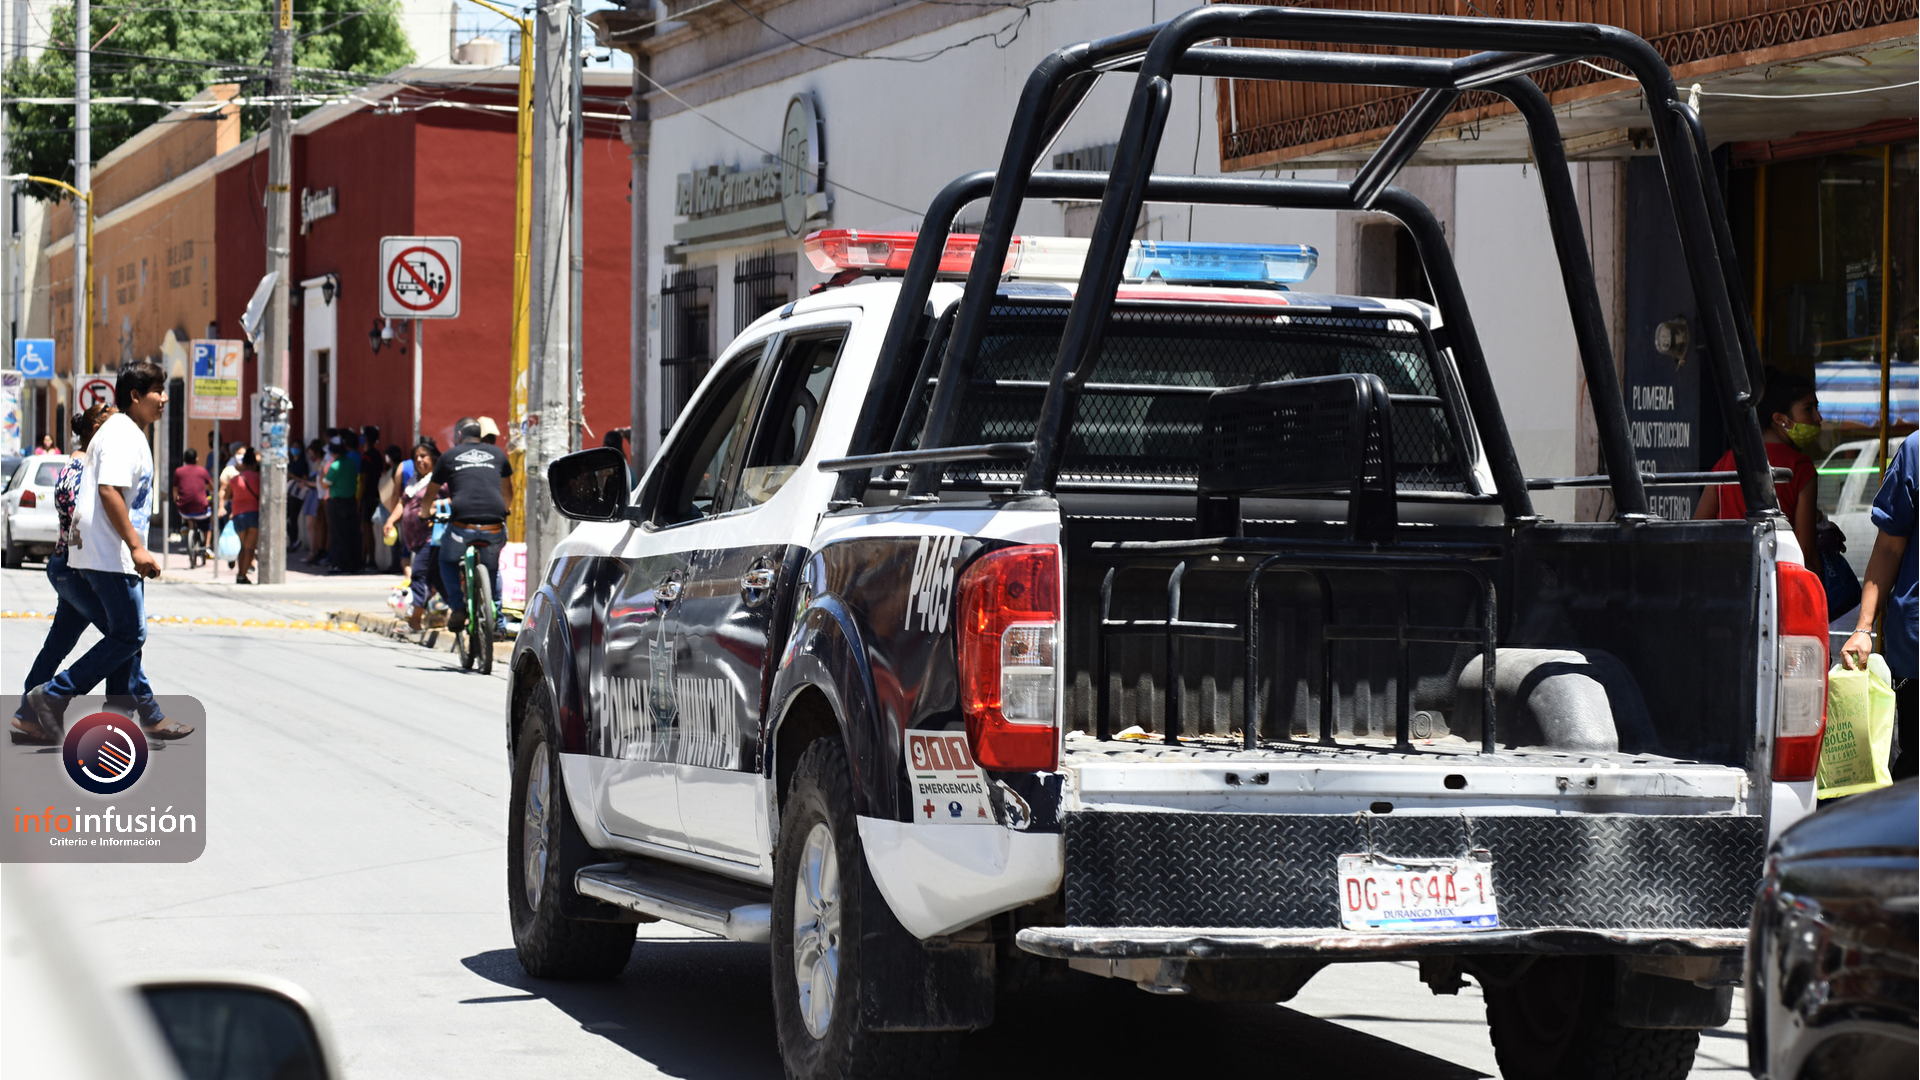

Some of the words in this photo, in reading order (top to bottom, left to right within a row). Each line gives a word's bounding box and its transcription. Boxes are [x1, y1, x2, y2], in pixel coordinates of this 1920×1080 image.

[195, 346, 208, 362] P
[1632, 386, 1674, 411] PLOMERIA
[1631, 421, 1690, 448] CONSTRUCCION
[904, 535, 963, 634] P465
[599, 676, 652, 762] POLICIA
[676, 678, 741, 770] MUNICIPAL
[1837, 721, 1853, 731] UNA
[1824, 730, 1855, 747] BOLSA
[913, 741, 967, 767] 911
[919, 782, 983, 795] EMERGENCIAS
[1384, 910, 1432, 920] DURANGO
